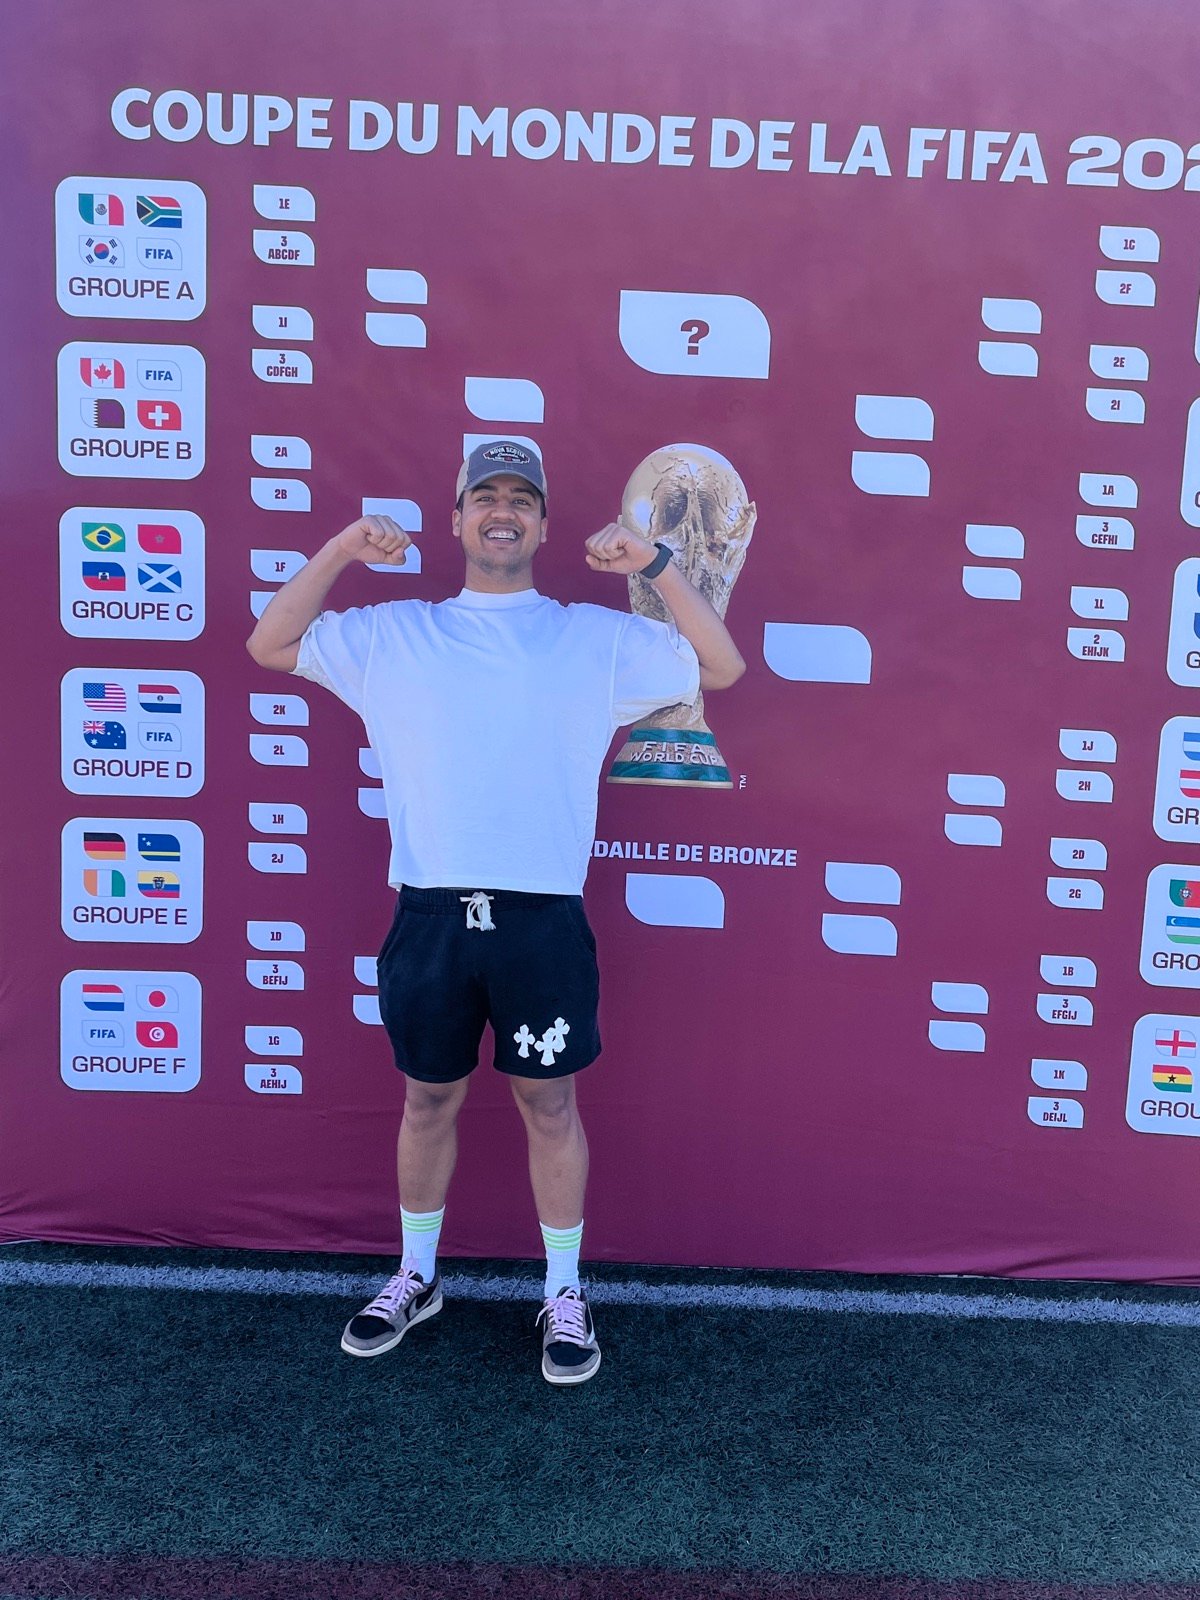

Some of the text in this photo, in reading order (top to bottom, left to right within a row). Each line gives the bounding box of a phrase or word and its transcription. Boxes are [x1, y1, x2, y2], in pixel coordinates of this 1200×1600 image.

[111, 88, 1200, 191] COUPE DU MONDE DE LA FIFA 20
[278, 197, 290, 210] 1E
[280, 235, 288, 247] 3
[1123, 238, 1136, 251] 1C
[144, 248, 174, 260] FIFA
[267, 248, 301, 261] ABCDF
[68, 276, 195, 301] GROUPE A
[1119, 282, 1132, 295] 2F
[278, 316, 288, 328] 1I
[681, 320, 709, 355] ?
[278, 353, 286, 365] 3
[1113, 356, 1126, 368] 2E
[145, 369, 174, 382] FIFA
[266, 365, 298, 378] CDFGH
[1110, 399, 1121, 411] 2I
[70, 437, 192, 460] GROUPE B
[274, 446, 288, 458] 2A
[274, 488, 288, 500] 2B
[1102, 484, 1115, 496] 1A
[1101, 521, 1109, 533] 3
[275, 561, 286, 573] 1F
[1094, 598, 1105, 610] 1L
[72, 600, 193, 622] GROUPE C
[1093, 633, 1101, 645] 2
[1081, 645, 1110, 658] EHIJK
[272, 704, 286, 716] 2K
[146, 731, 174, 743] FIFA
[273, 744, 285, 756] 2L
[642, 741, 706, 754] FIFA
[1081, 740, 1094, 751] 1J
[631, 752, 718, 766] WORLD CUP
[73, 758, 192, 779] GROUPE D
[739, 774, 747, 790] TM
[1078, 780, 1091, 792] 2H
[272, 813, 284, 825] 1H
[271, 853, 284, 864] 2J
[590, 840, 798, 867] DAILLE DE BRONZE
[1072, 849, 1085, 860] 2D
[1068, 888, 1082, 899] 2G
[73, 905, 188, 925] GROUPE E
[270, 931, 282, 942] 1D
[1152, 951, 1200, 971] GRO
[272, 963, 279, 974] 3
[1062, 966, 1074, 977] 1B
[262, 975, 288, 986] BEFIJ
[1062, 998, 1069, 1009] 3
[1051, 1009, 1078, 1021] EFGIJ
[89, 1028, 117, 1039] FIFA
[268, 1035, 280, 1046] 1G
[72, 1055, 187, 1074] GROUPE F
[270, 1067, 277, 1078] 3
[1053, 1069, 1066, 1080] 1K
[259, 1078, 287, 1089] AEHIJ
[1052, 1101, 1060, 1111] 3
[1140, 1099, 1200, 1120] GROU
[1042, 1111, 1068, 1123] DEIJL
